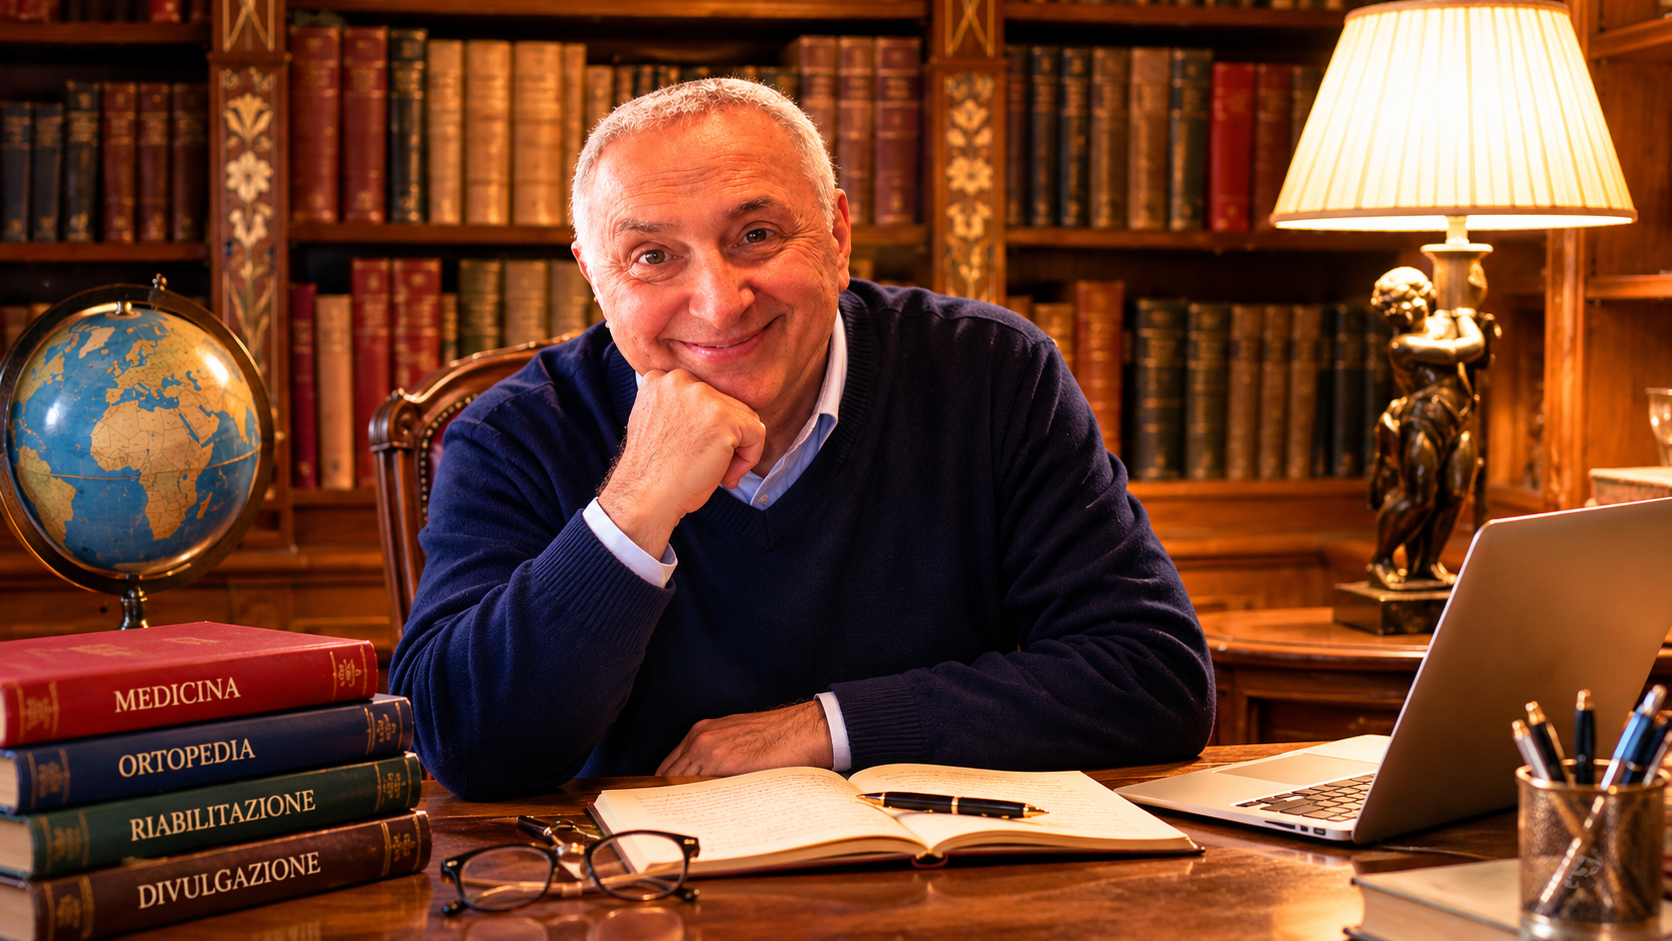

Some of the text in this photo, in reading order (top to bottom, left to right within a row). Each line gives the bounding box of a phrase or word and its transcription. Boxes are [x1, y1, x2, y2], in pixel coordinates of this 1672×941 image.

[114, 677, 241, 712] MEDICINA
[118, 738, 255, 777] ORTOPEDIA
[130, 790, 316, 841] RIABILITAZIONE
[138, 852, 321, 909] DIVULGAZIONE
